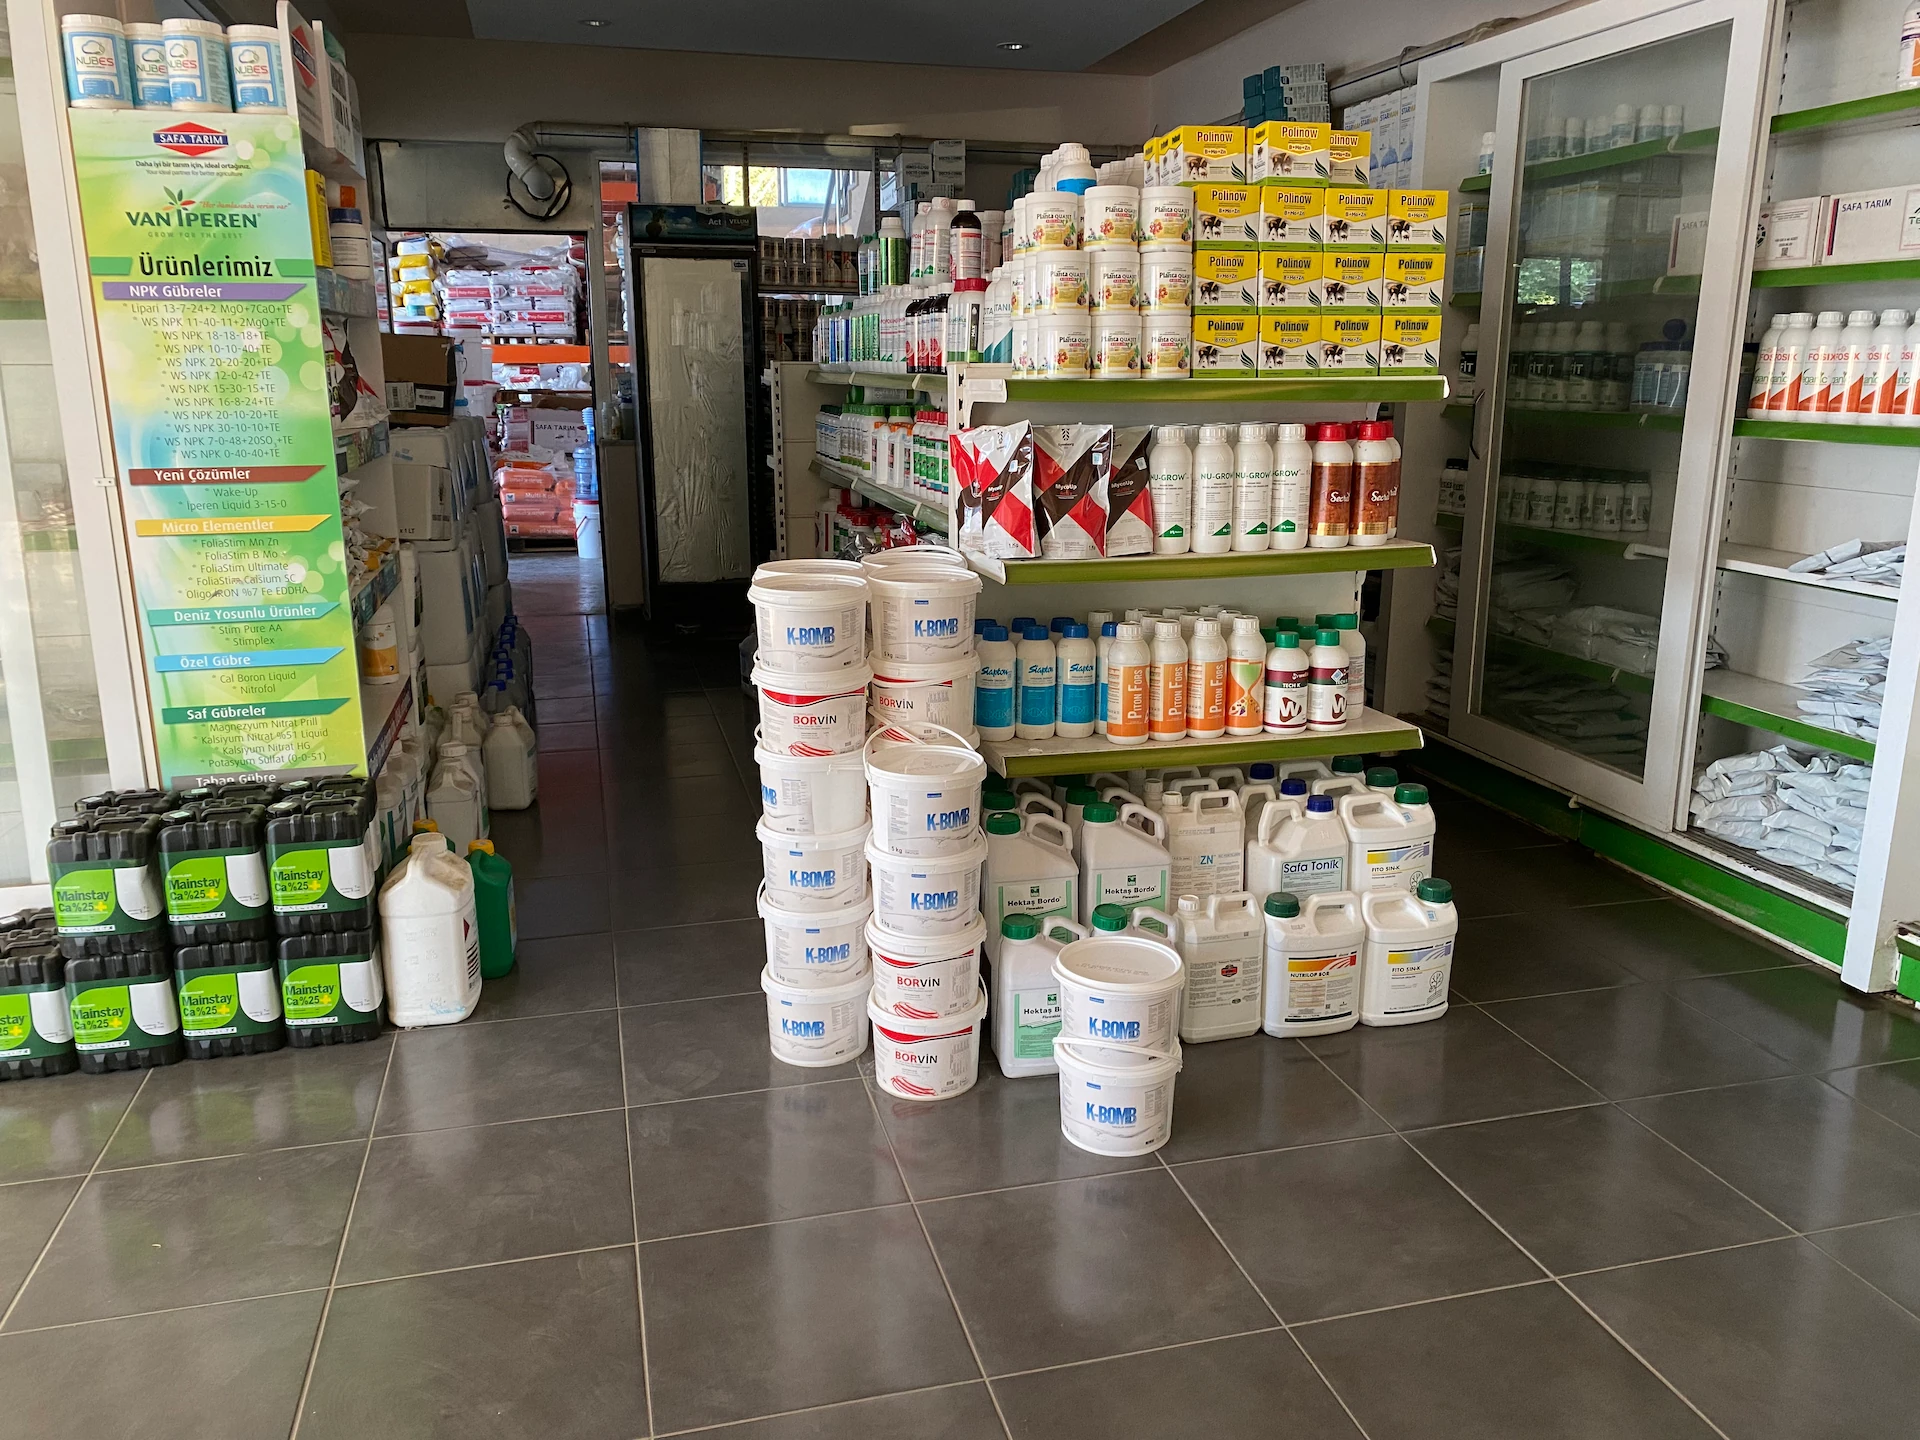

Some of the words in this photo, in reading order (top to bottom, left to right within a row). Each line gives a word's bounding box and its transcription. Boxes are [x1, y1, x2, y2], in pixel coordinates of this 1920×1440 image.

[1197, 131, 1233, 142] Polinow
[1282, 126, 1318, 138] Polinow
[159, 133, 186, 144] SAFA
[189, 134, 223, 145] TARIM
[1212, 190, 1247, 202] Polinow
[1278, 192, 1312, 204] Polinow
[1842, 202, 1862, 212] SAFA
[1865, 198, 1892, 209] TARIM
[126, 212, 170, 227] VAN
[139, 252, 273, 277] Ürünlerimiz
[130, 286, 158, 297] NPK
[163, 285, 222, 298] Gübreler
[131, 304, 159, 314] Lipari
[164, 304, 216, 313] 13-7-24+2
[220, 304, 292, 315] MgO+7CaO+TE
[141, 318, 158, 327] WS
[162, 318, 182, 326] NPK
[187, 317, 286, 328] 11-40-11+2MgO+TE
[162, 332, 178, 340] WS
[182, 331, 202, 340] NPK
[206, 331, 269, 340] 18-18-18+TE
[164, 345, 180, 354] WS
[184, 344, 205, 354] NPK
[209, 344, 271, 353] 10-10-40+TE
[166, 358, 182, 367] WS
[186, 358, 206, 366] NPK
[210, 357, 272, 366] 20-20-20+TE
[171, 371, 187, 380] WS
[190, 371, 210, 380] NPK
[216, 370, 271, 380] 12-0-42+TE
[169, 385, 185, 394] WS
[189, 384, 209, 393] NPK
[214, 384, 275, 393] 15-30-15+TE
[174, 398, 190, 407] WS
[194, 398, 214, 406] NPK
[219, 397, 274, 406] 16-8-24+TE
[173, 411, 189, 420] WS
[192, 410, 213, 420] NPK
[217, 410, 278, 419] 20-10-20+TE
[174, 424, 190, 433] WS
[194, 424, 214, 433] NPK
[218, 424, 280, 432] 30-10-10+TE
[181, 450, 197, 459] WS
[200, 450, 221, 458] NPK
[224, 449, 280, 458] 0-40-40+TE
[154, 470, 184, 482] Yeni
[188, 469, 250, 483] Çözümler
[213, 488, 258, 498] Wake-Up
[222, 500, 250, 511] Liquid
[254, 500, 287, 509] 3-15-0
[162, 522, 199, 533] Micro
[203, 520, 274, 532] Elementler
[201, 538, 245, 548] FoliaStim
[249, 538, 264, 547] Mn
[267, 538, 279, 546] Zn
[205, 551, 249, 560] FoliaStim
[253, 550, 259, 559] B
[262, 550, 278, 559] Mo
[200, 563, 245, 573] FoliaStim
[248, 562, 289, 572] Ultimate
[285, 574, 296, 583] SC
[186, 590, 211, 601] Oligo
[242, 588, 257, 597] %7
[262, 587, 273, 596] Fe
[276, 586, 308, 595] EDDHA
[174, 610, 210, 622] Deniz
[214, 608, 265, 620] Yosunlu
[269, 606, 316, 618] Ürünler
[219, 625, 240, 634] Stim
[244, 624, 266, 634] Pure
[269, 624, 282, 633] AA
[914, 618, 958, 638] K-BOMB
[233, 636, 275, 648] Stimplex
[787, 627, 835, 645] K-BOMB
[180, 655, 208, 668] Özel
[213, 655, 250, 666] Gübre
[220, 674, 234, 683] Cal
[238, 673, 265, 683] Boron
[269, 671, 296, 683] Liquid
[240, 684, 276, 694] Nitrofol
[880, 697, 914, 709] BORVİN
[187, 708, 207, 720] Saf
[212, 706, 266, 718] Gübreler
[210, 721, 268, 733] Magnezyum
[271, 720, 297, 728] Nitrat
[300, 717, 318, 726] Prill
[793, 716, 836, 725] BORVİN
[202, 733, 244, 746] Kalsiyum
[248, 732, 274, 741] Nitrat
[276, 730, 297, 740] %51
[301, 728, 328, 740] Liquid
[223, 743, 266, 755] Kalsiyum
[268, 742, 295, 752] Nitrat
[297, 741, 310, 750] HG
[208, 756, 254, 767] Potasyum
[288, 752, 327, 763] (0-0-51)
[239, 773, 276, 784] Gübre
[927, 808, 970, 832] K-BOMB
[1201, 856, 1213, 864] ZN
[1284, 864, 1308, 874] Safa
[1312, 860, 1339, 870] Tonik
[274, 870, 323, 881] Mainstay
[790, 870, 836, 888] K-BOMB
[168, 878, 220, 890] Mainstay
[288, 882, 308, 890] %25
[184, 890, 206, 898] %25
[897, 976, 940, 987] BORVİN
[1089, 1017, 1140, 1039] K-BOMB
